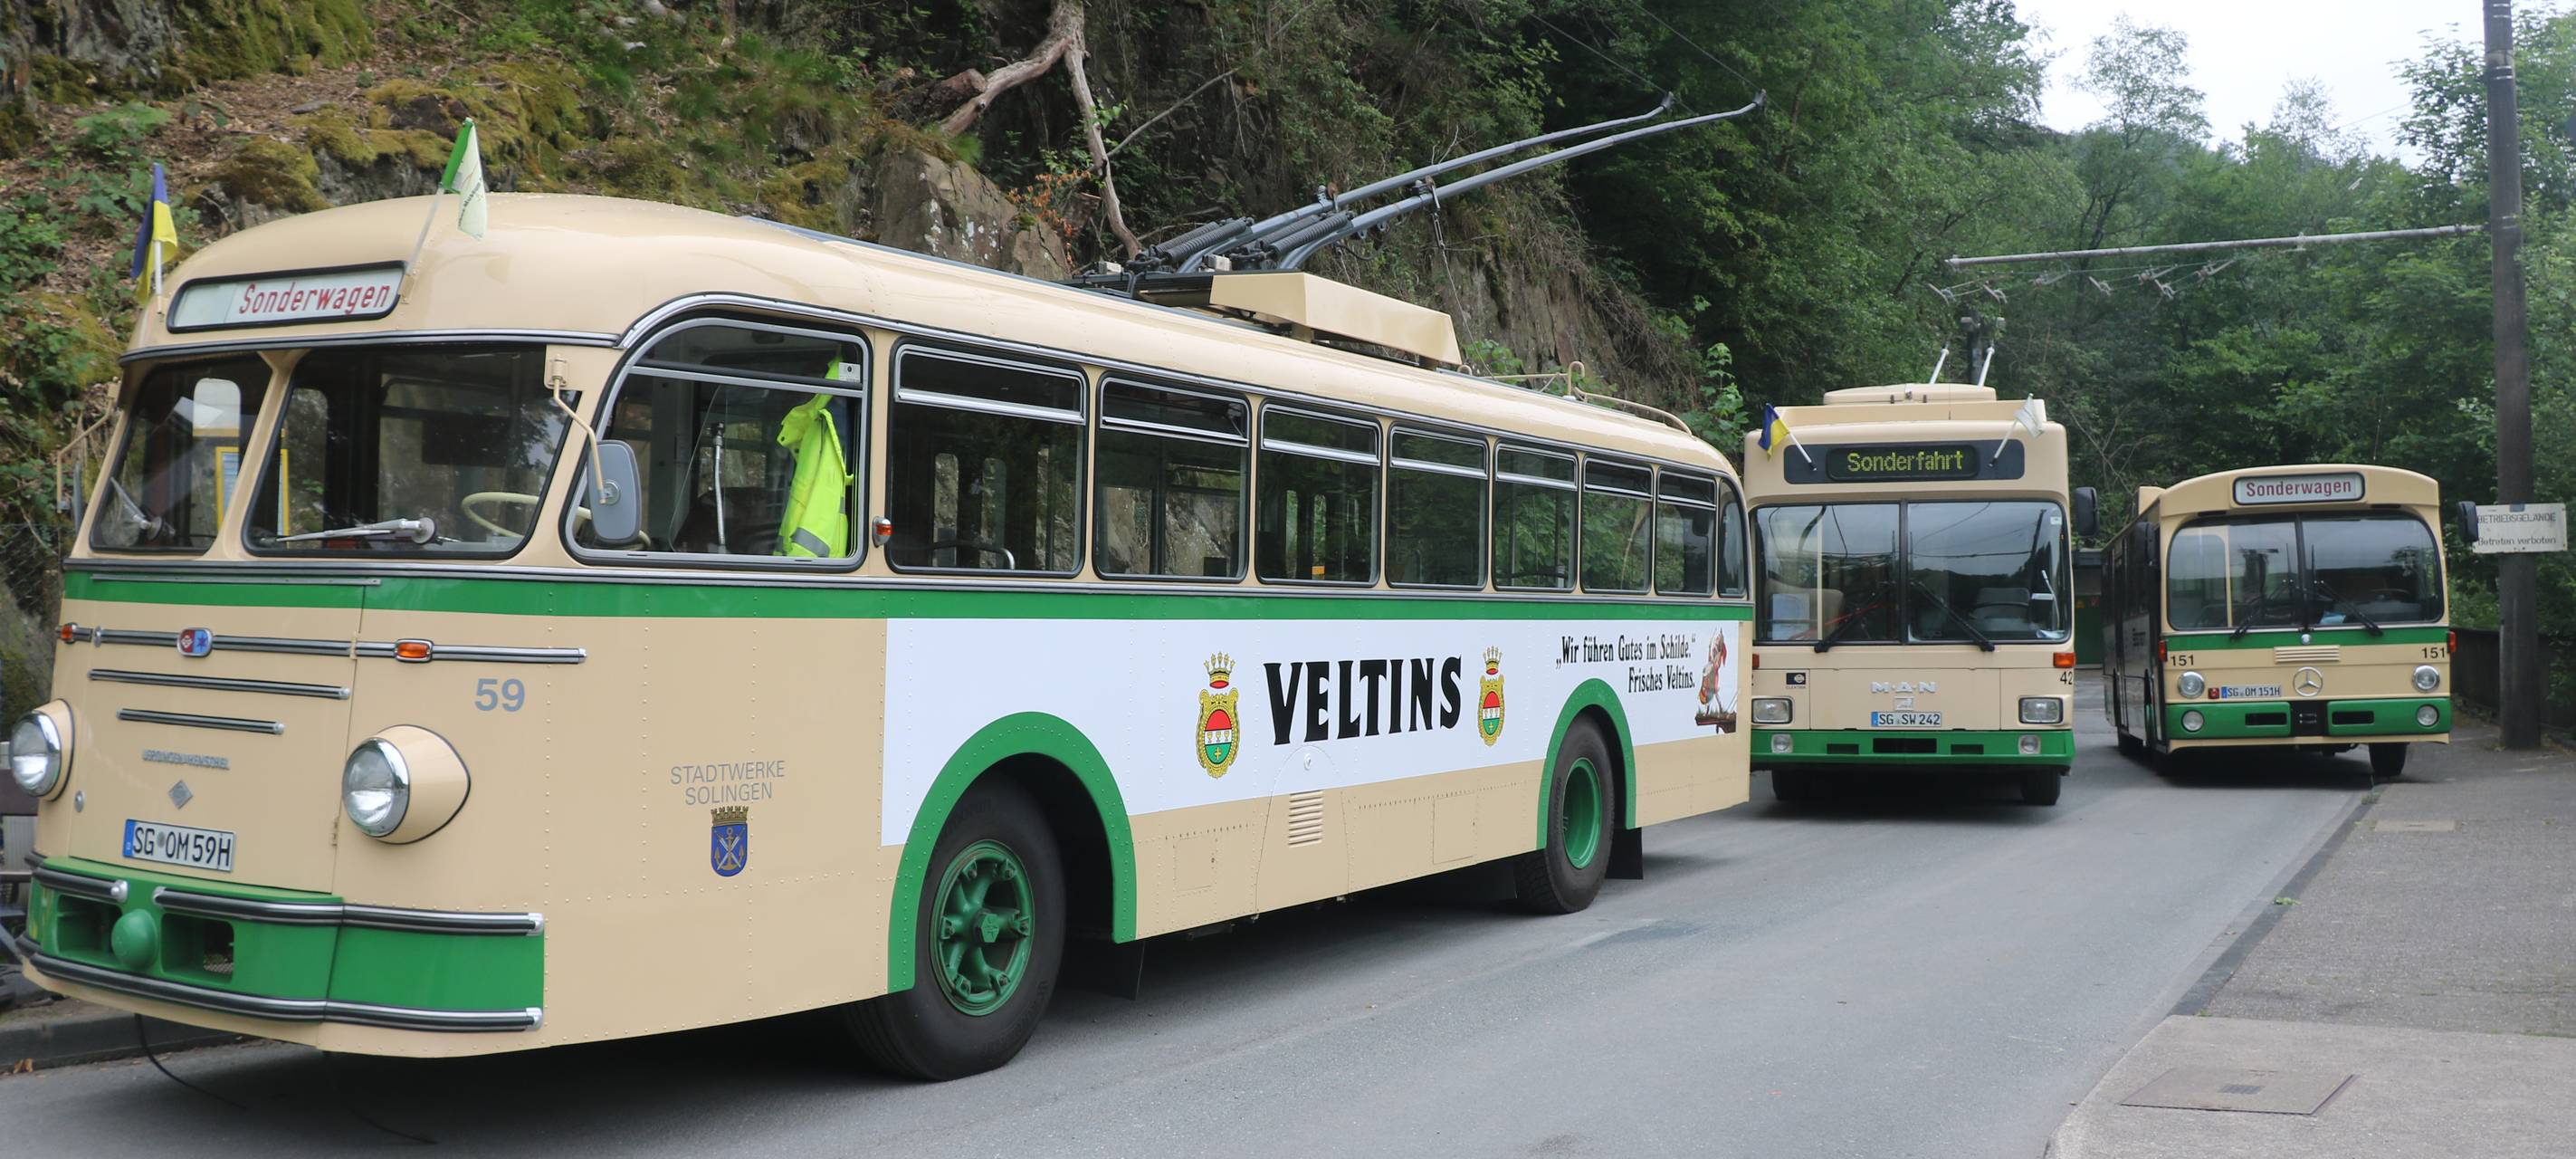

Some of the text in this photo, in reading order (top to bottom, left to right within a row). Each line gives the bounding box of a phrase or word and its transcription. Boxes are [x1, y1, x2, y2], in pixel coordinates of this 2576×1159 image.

[239, 282, 390, 315] Sonderwagen
[1847, 451, 1963, 472] Sonderfahrt
[2247, 481, 2352, 497] Sonderwagen
[2517, 536, 2556, 544] verboten
[1583, 636, 1614, 664] führen
[1617, 635, 1643, 662] Gutes
[1646, 637, 1656, 660] im
[2171, 655, 2194, 666] 151
[2421, 647, 2445, 658] 151
[1628, 665, 1695, 694] Frisches Veltins.
[474, 678, 525, 713] 59
[1263, 655, 1462, 745] VELTINS
[1879, 714, 1941, 725] SG SW 242
[671, 761, 785, 785] STADTWERKE
[685, 782, 772, 805] SOLINGEN
[133, 827, 155, 856] SG
